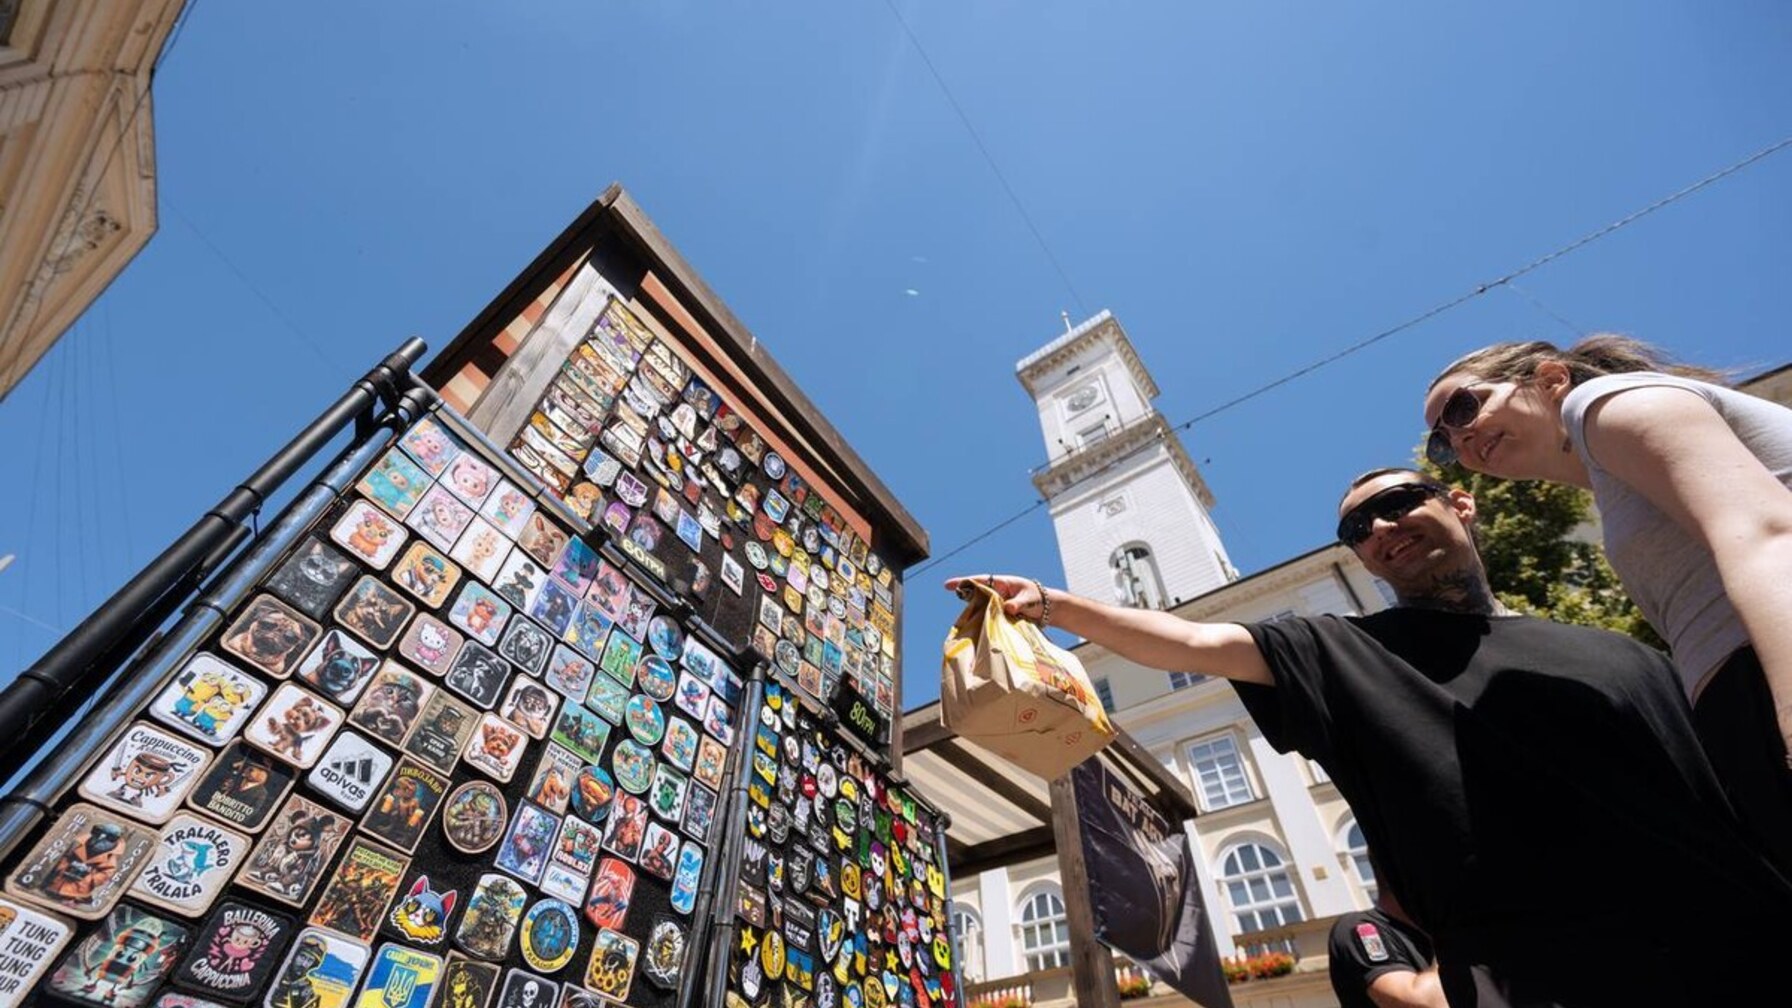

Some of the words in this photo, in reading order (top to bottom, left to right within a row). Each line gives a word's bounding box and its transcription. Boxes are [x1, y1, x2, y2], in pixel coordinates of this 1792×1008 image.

[130, 730, 200, 763] Cappuccino
[206, 800, 246, 823] BANDITO
[164, 826, 231, 867] TRALALERO
[144, 866, 202, 899] TRALALA
[18, 920, 59, 945] TUNG
[224, 909, 280, 940] BALLERINA
[5, 936, 47, 961] TUNG
[0, 975, 20, 995] UR
[190, 957, 252, 989] CAPPUCCINA
